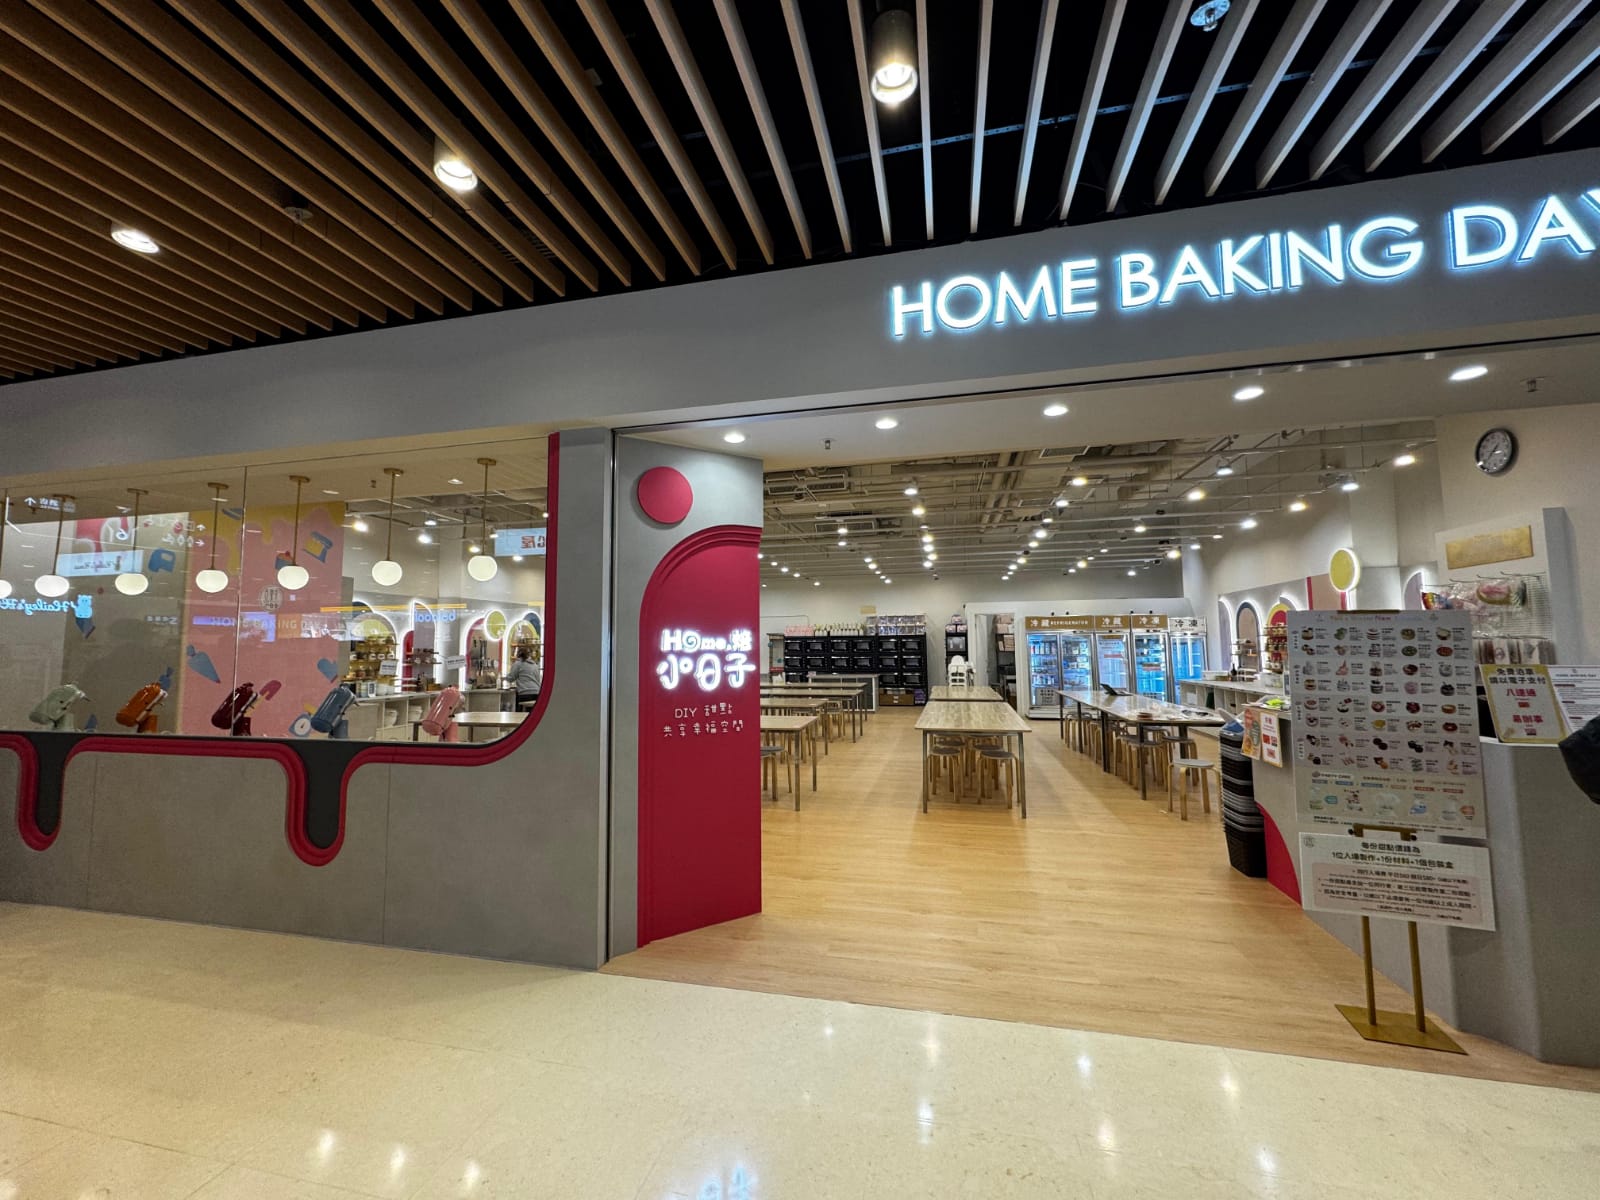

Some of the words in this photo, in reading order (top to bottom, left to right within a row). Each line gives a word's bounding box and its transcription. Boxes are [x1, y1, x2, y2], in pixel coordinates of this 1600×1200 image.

[888, 256, 1099, 339] HOME
[1117, 215, 1425, 309] BAKING
[656, 652, 757, 692] 小日子
[674, 707, 698, 719] DIY
[703, 702, 733, 717] 甜點
[663, 719, 744, 738] 共享幸福空間
